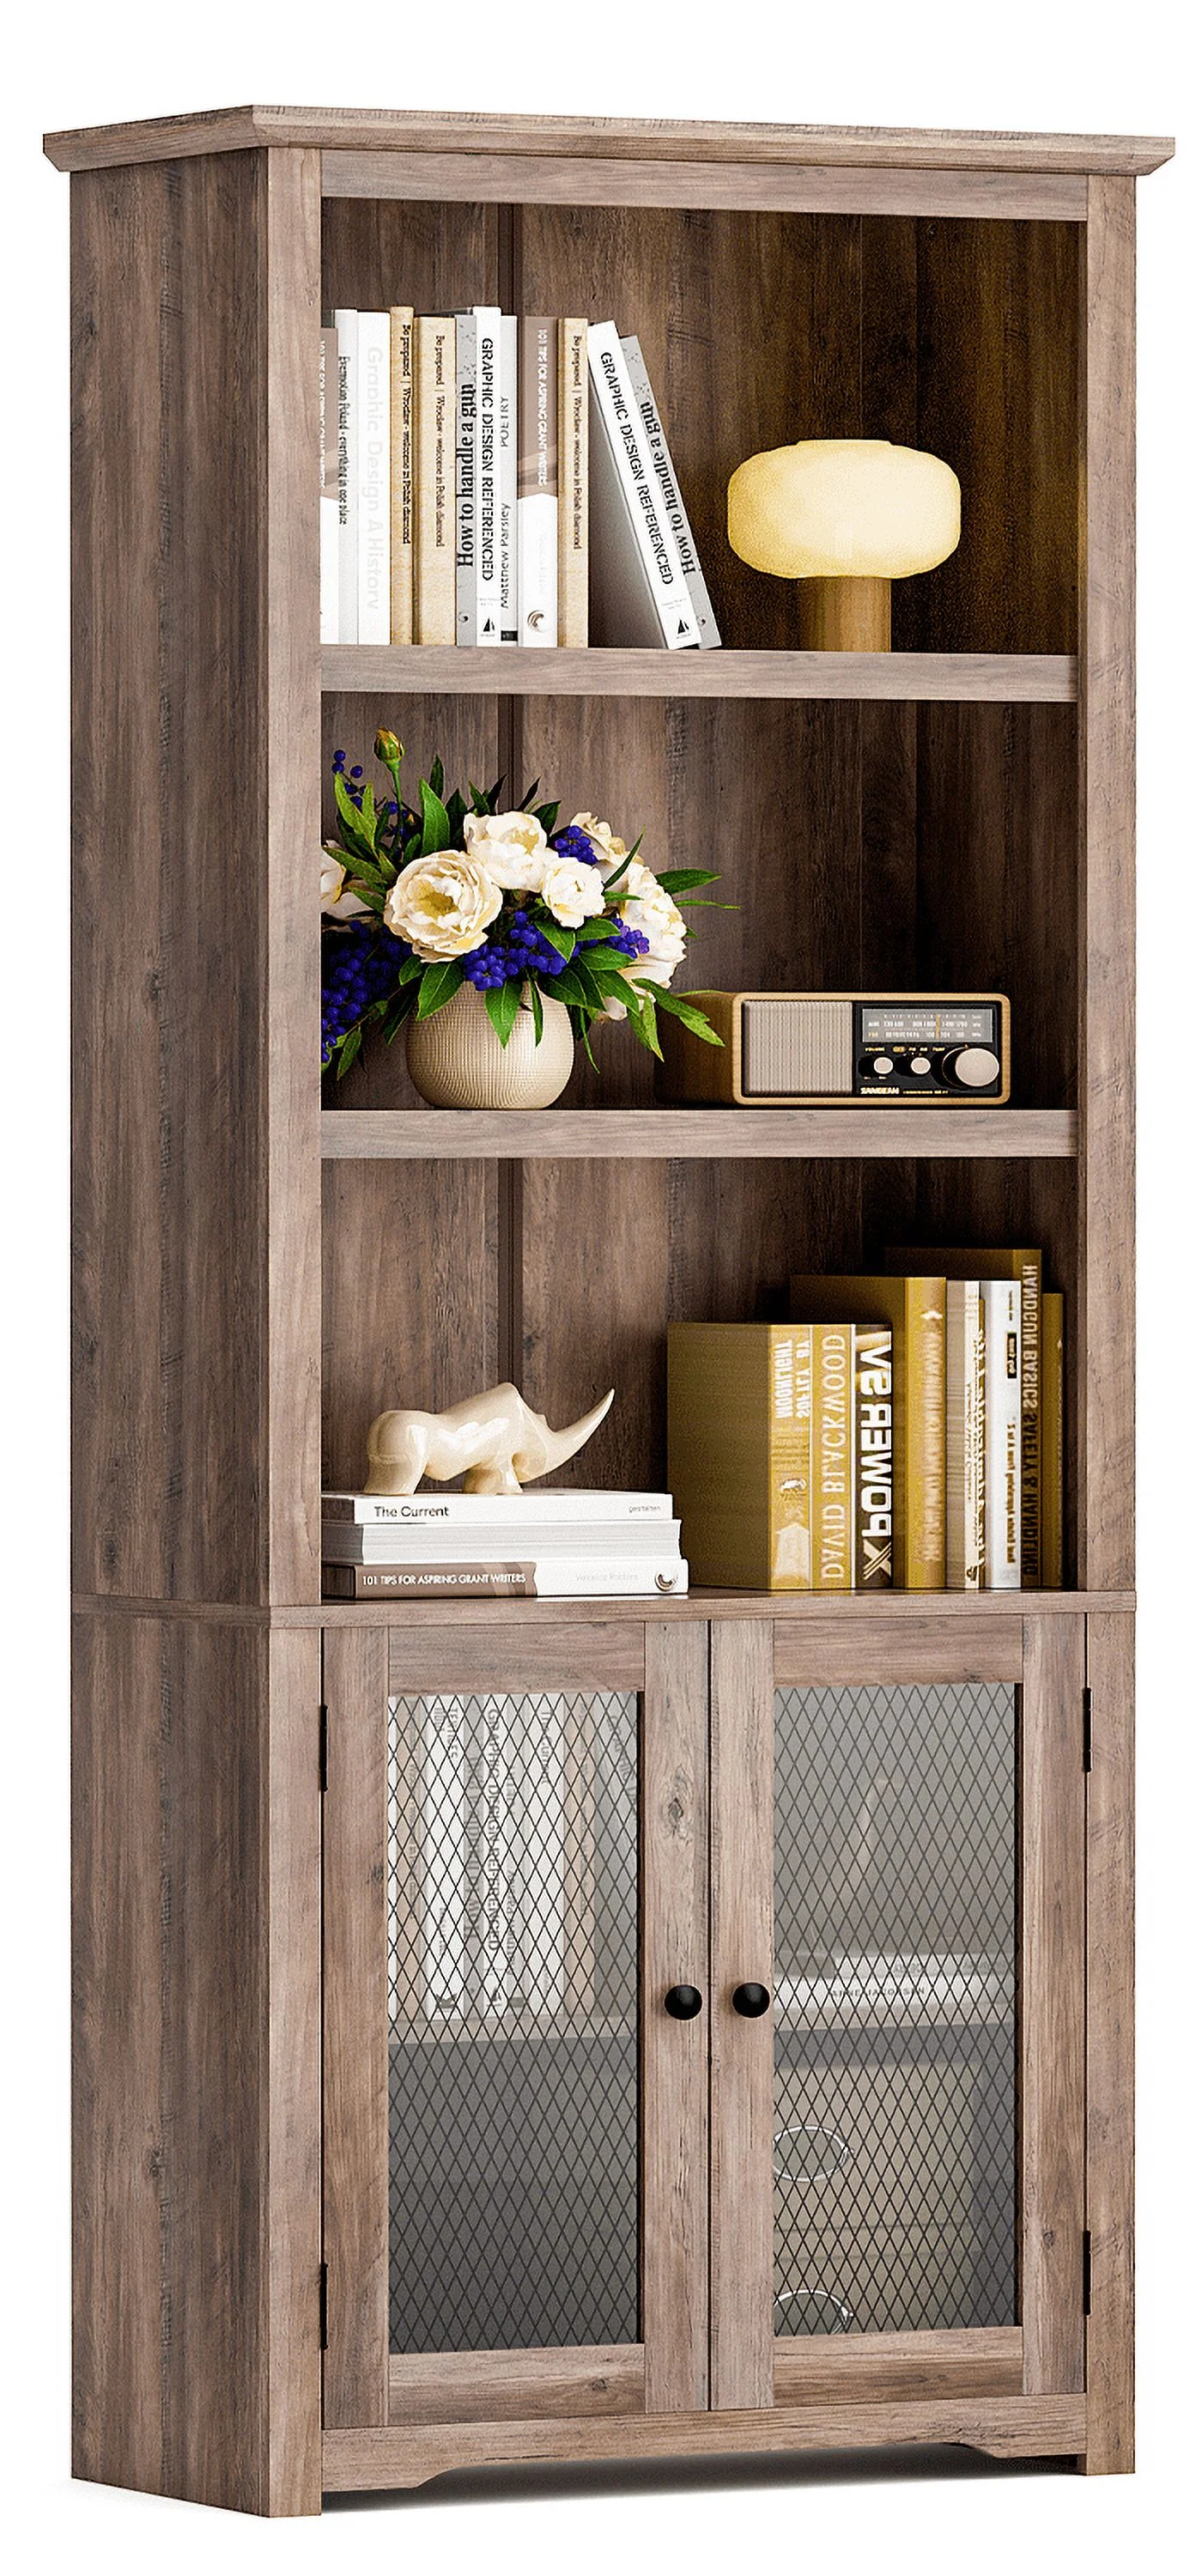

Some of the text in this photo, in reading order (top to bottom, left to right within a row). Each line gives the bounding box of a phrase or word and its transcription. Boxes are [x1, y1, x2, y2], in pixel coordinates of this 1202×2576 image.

[456, 384, 477, 567] How to handle a gun
[482, 337, 494, 581] GRAPHIC DESIGN REFERENCED
[501, 396, 509, 447] POETRY
[601, 351, 674, 585] GRAPHIC DESIGN REFERENCED
[640, 401, 695, 574] How to handle a gun
[362, 1573, 526, 1585] 101 TIPS FOR ASPIRING GRANT WRITERS
[373, 1505, 449, 1517] The Current
